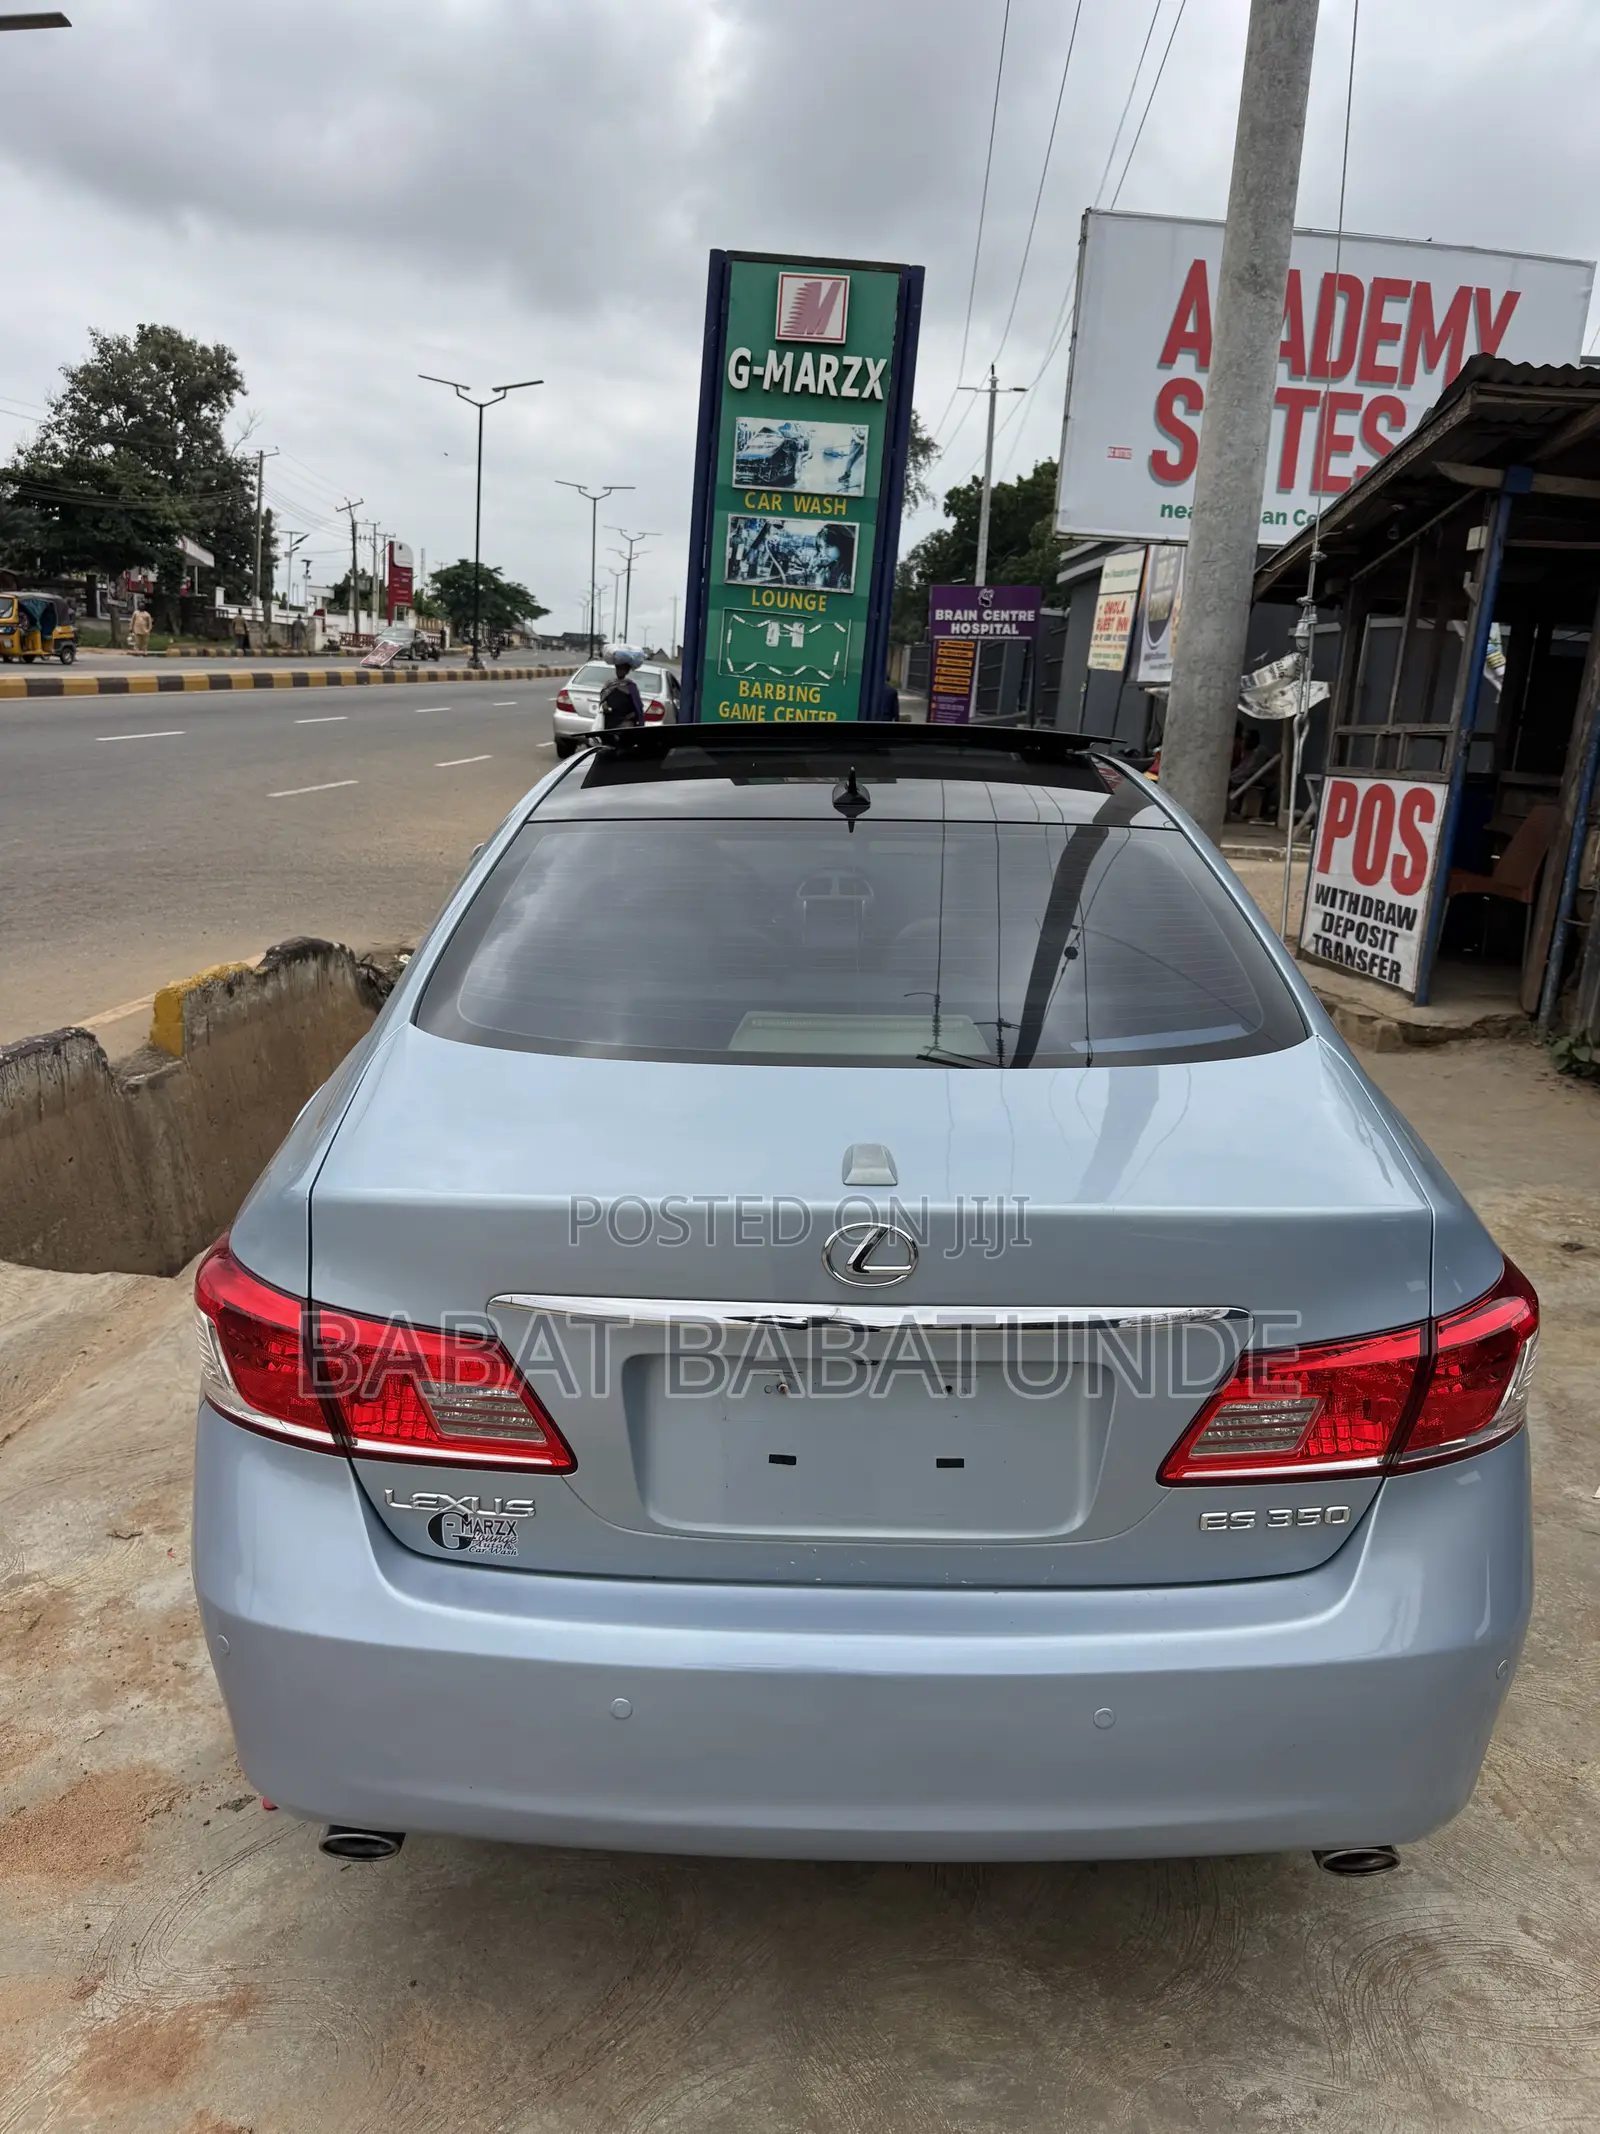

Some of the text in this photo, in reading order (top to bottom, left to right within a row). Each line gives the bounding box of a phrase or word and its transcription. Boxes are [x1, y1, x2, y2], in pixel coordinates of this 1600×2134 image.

[1159, 258, 1521, 390] AADEMY
[727, 347, 888, 400] G-MARZX
[1149, 377, 1407, 494] STES
[744, 491, 848, 516] CAR WASH
[751, 588, 828, 612] LOUNGE
[935, 609, 1036, 622] BRAIN CENTRE
[950, 623, 1020, 635] HOSPITAL
[738, 680, 822, 704] BARBING
[718, 701, 838, 723] GAME CENTER
[1316, 780, 1436, 896] POS
[1315, 883, 1418, 932] WITHDRAW
[1321, 912, 1400, 954] DEPOSIT
[1312, 933, 1402, 985] TRANSFER
[384, 1488, 536, 1518] LEXUS
[1199, 1505, 1351, 1531] ES 350
[469, 1545, 518, 1556] Car Wash
[472, 1531, 518, 1546] Lounge
